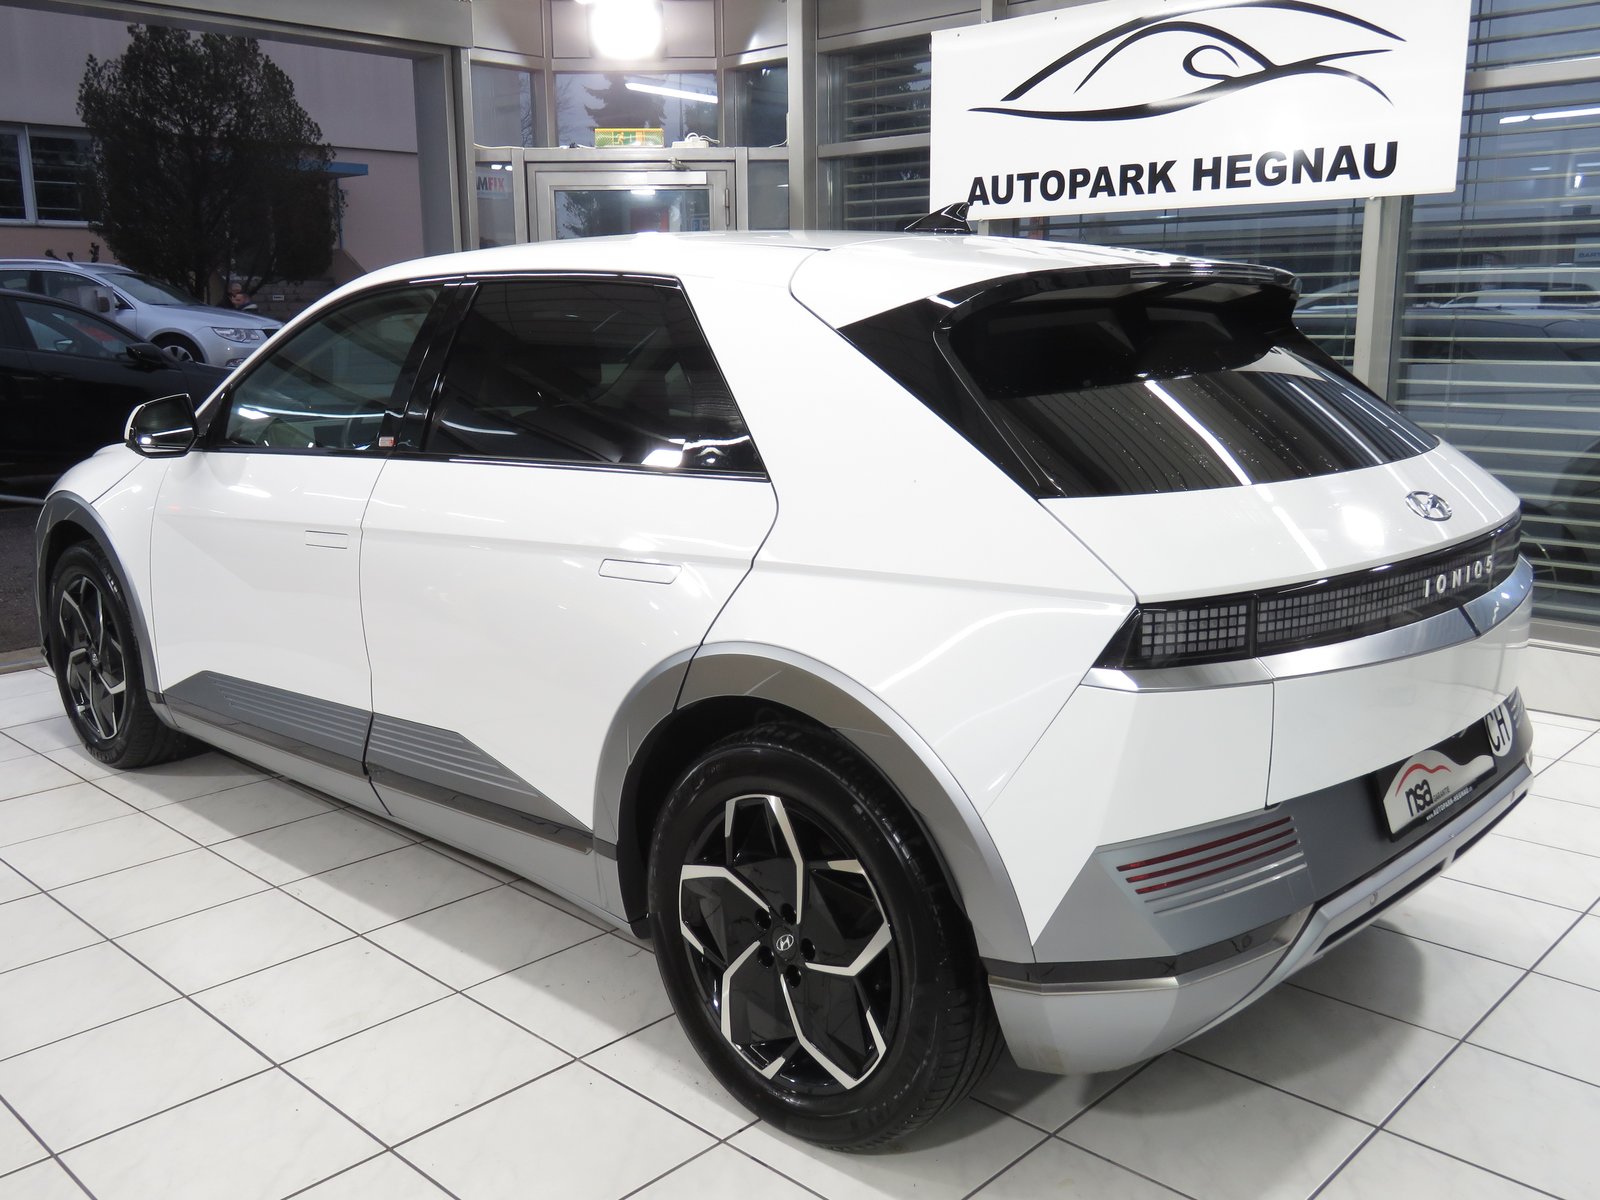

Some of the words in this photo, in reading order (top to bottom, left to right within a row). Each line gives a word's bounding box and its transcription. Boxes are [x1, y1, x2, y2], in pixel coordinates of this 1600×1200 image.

[967, 159, 1178, 206] AUTOPARK
[1191, 141, 1398, 191] HEGNAU
[1486, 706, 1511, 752] CH
[1405, 779, 1434, 817] nsa
